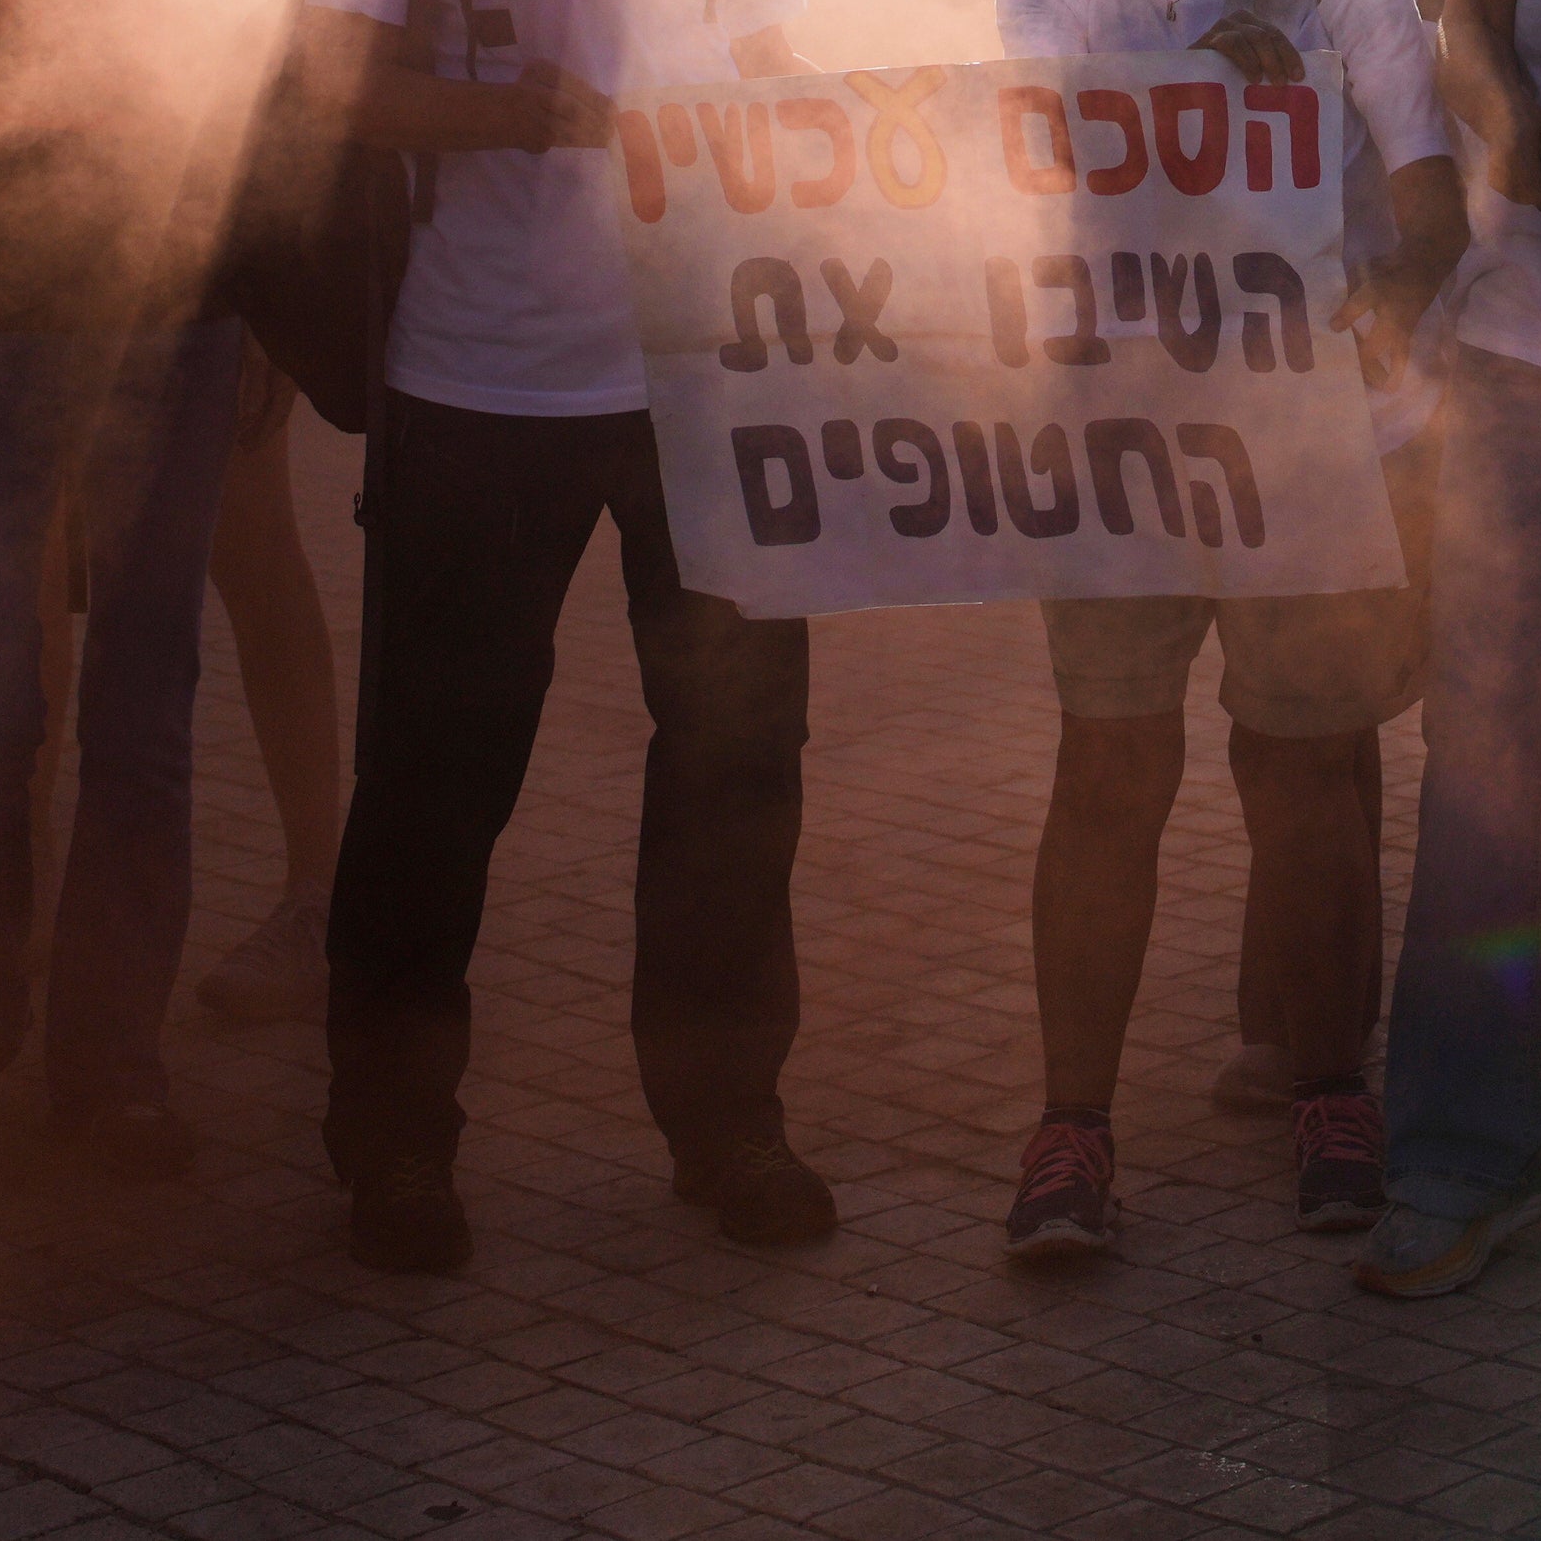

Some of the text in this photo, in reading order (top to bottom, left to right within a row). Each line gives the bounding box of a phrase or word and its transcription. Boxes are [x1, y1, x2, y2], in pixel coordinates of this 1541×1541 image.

[996, 81, 1321, 196] הסכם
[719, 251, 1315, 373] השיבו את
[730, 417, 1266, 548] החטופים
